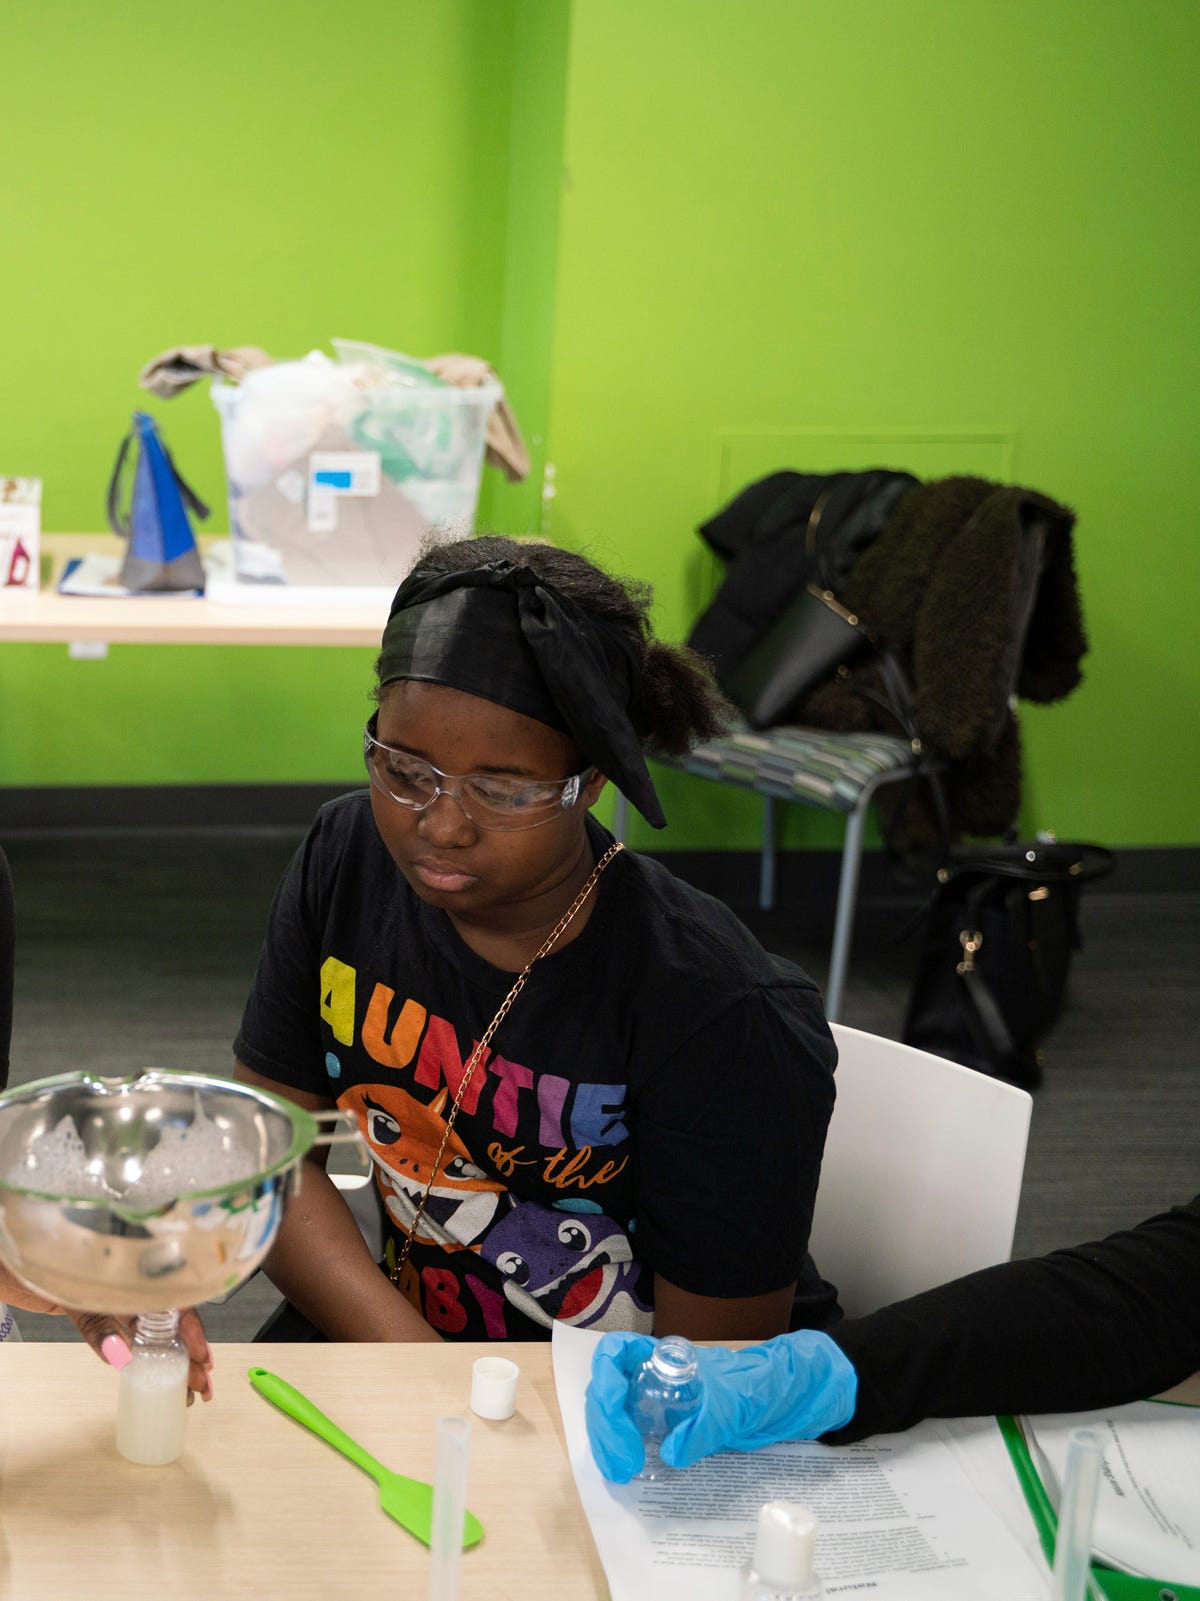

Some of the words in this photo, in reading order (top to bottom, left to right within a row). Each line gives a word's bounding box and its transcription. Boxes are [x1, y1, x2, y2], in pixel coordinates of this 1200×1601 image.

[320, 956, 629, 1150] AUNTIE
[487, 1142, 537, 1176] of
[542, 1145, 629, 1189] the
[825, 1581, 878, 1595] Natural
